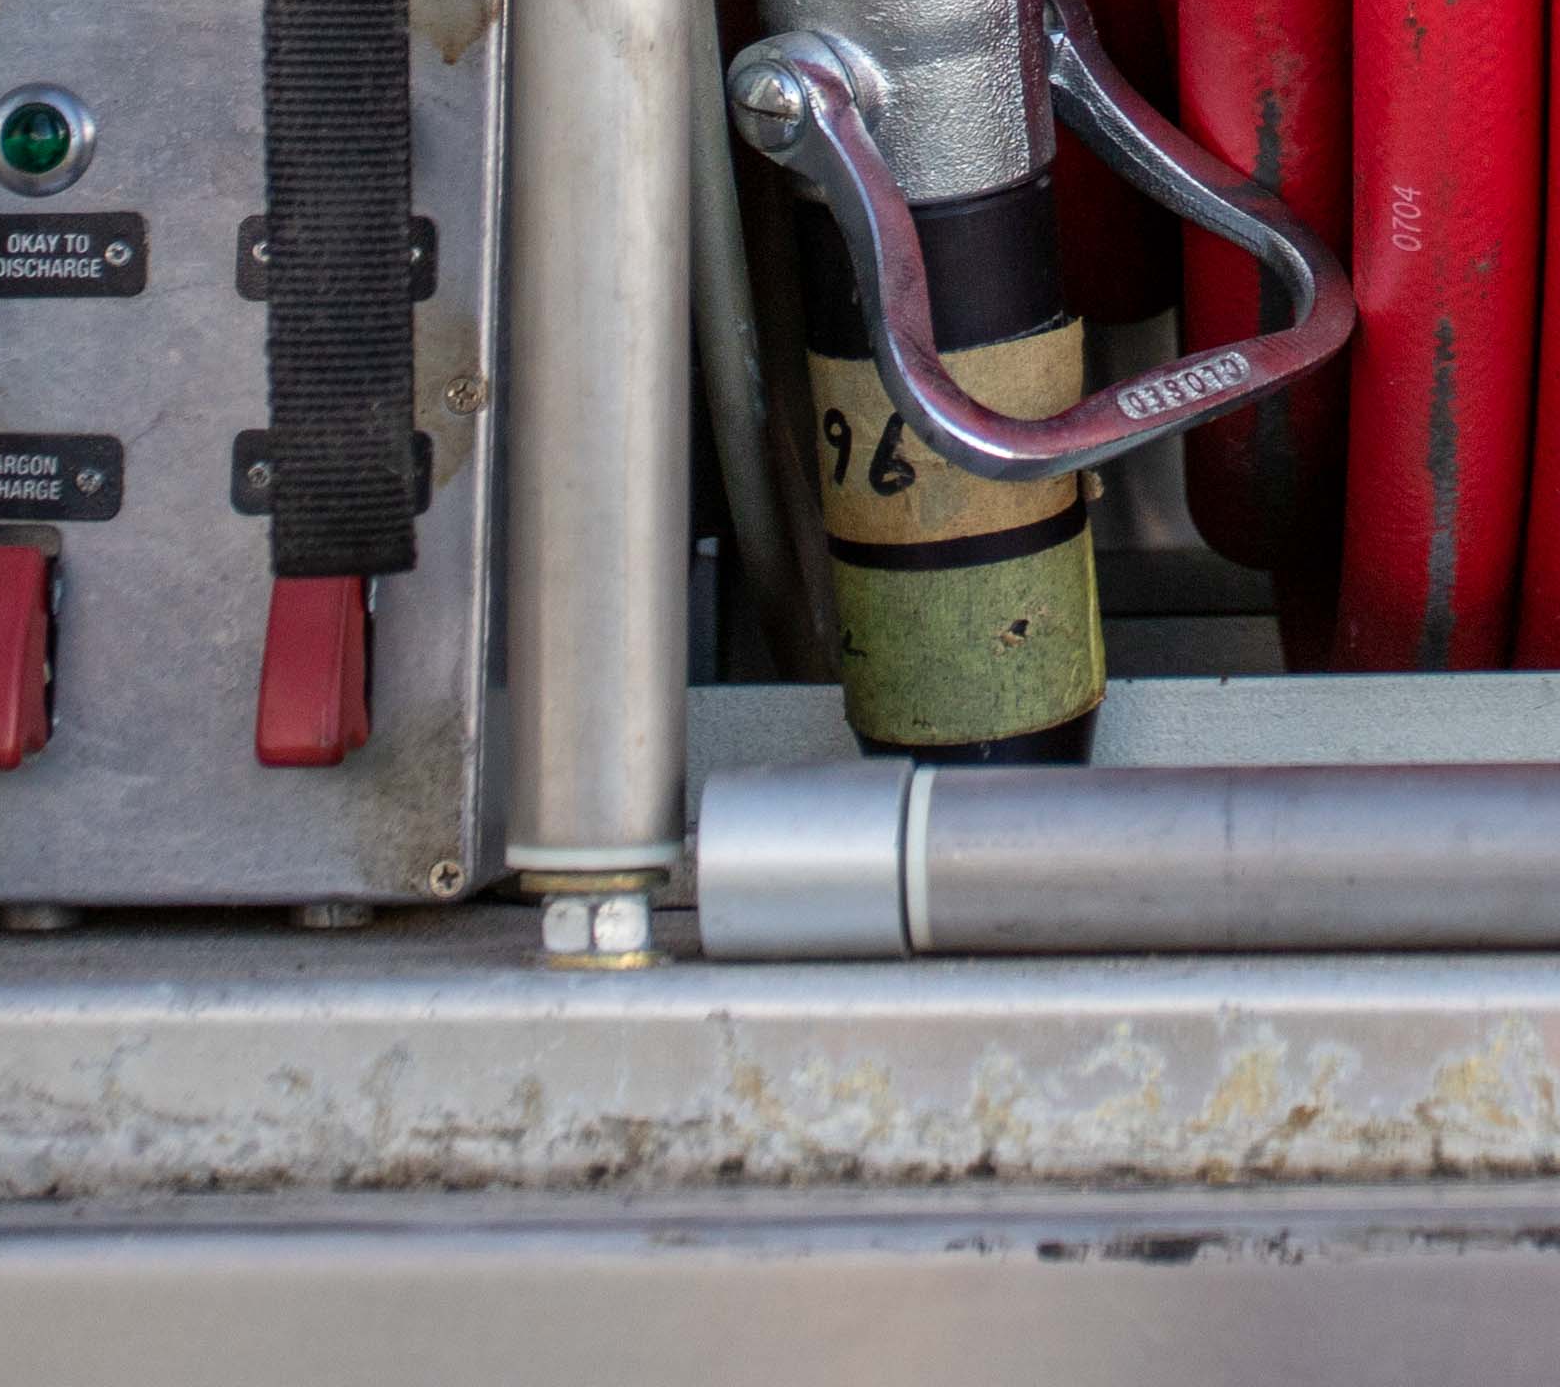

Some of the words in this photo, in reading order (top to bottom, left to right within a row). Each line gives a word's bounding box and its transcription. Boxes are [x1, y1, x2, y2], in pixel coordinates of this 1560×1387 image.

[7, 233, 61, 254] OKAY
[64, 233, 90, 254] TO
[1391, 184, 1423, 254] 0704
[1126, 359, 1242, 415] CLOSED
